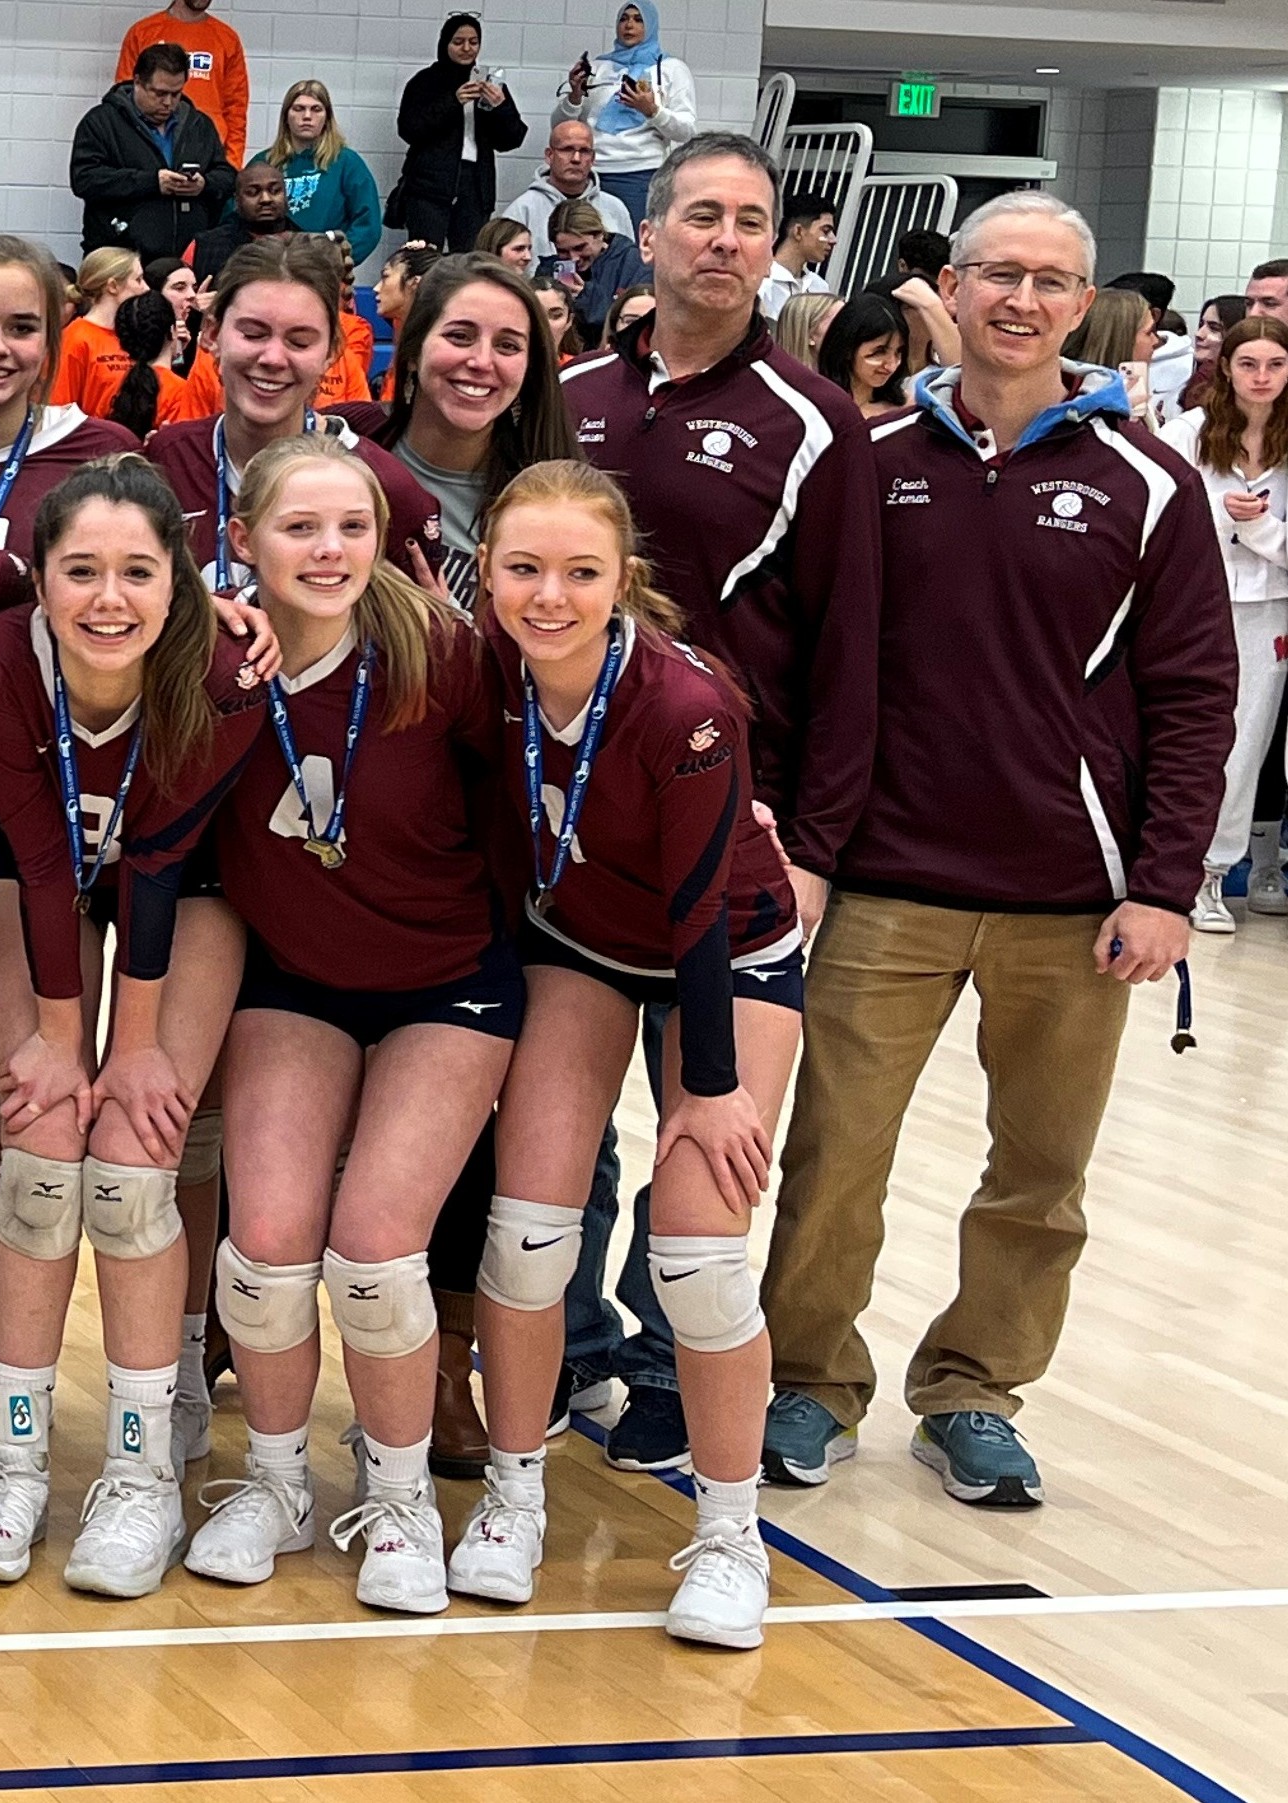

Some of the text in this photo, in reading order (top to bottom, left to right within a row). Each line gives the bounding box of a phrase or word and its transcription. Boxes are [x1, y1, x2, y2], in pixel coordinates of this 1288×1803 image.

[899, 84, 935, 115] EXIT
[892, 478, 929, 491] Coach
[1030, 480, 1111, 507] WESTBOROUGH
[1036, 515, 1088, 534] RANGERS
[269, 754, 347, 859] 4
